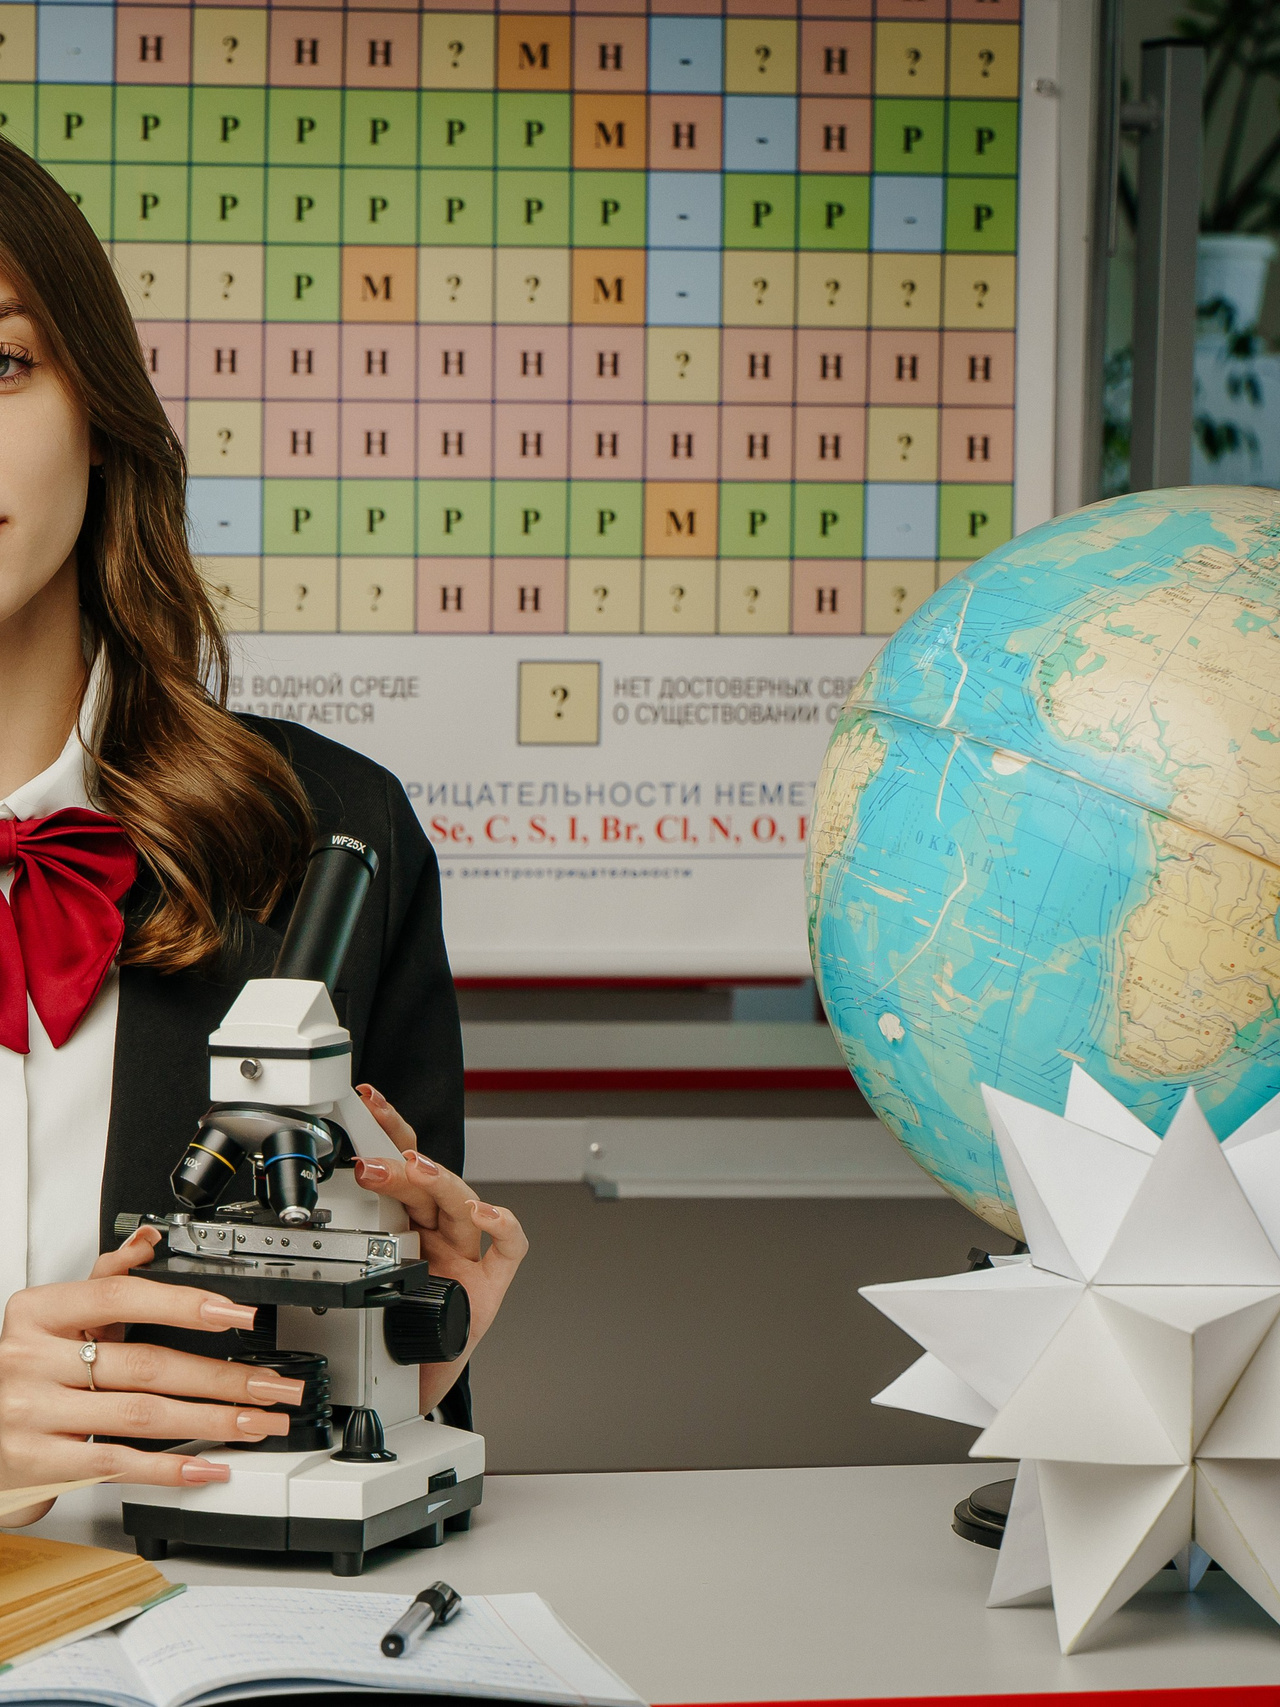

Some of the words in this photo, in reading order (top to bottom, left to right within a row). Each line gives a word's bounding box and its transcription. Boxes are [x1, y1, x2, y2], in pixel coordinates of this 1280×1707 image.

[251, 672, 344, 700] ВОДНОЙ
[349, 676, 418, 700] СРЕДЕ
[613, 676, 653, 699] НЕТ
[658, 677, 812, 700] ДОСТОВЕРНЫХ
[636, 703, 820, 726] СУЩЕСТВОВАНИИ
[429, 815, 474, 846] Se,
[483, 815, 518, 847] C,
[528, 816, 557, 847] S,
[568, 815, 589, 847] I,
[601, 815, 645, 847] Br,
[654, 815, 699, 847] Cl,
[710, 815, 742, 847] N,
[750, 816, 787, 847] O,
[331, 834, 367, 854] WF25X
[182, 1156, 202, 1171] 10X
